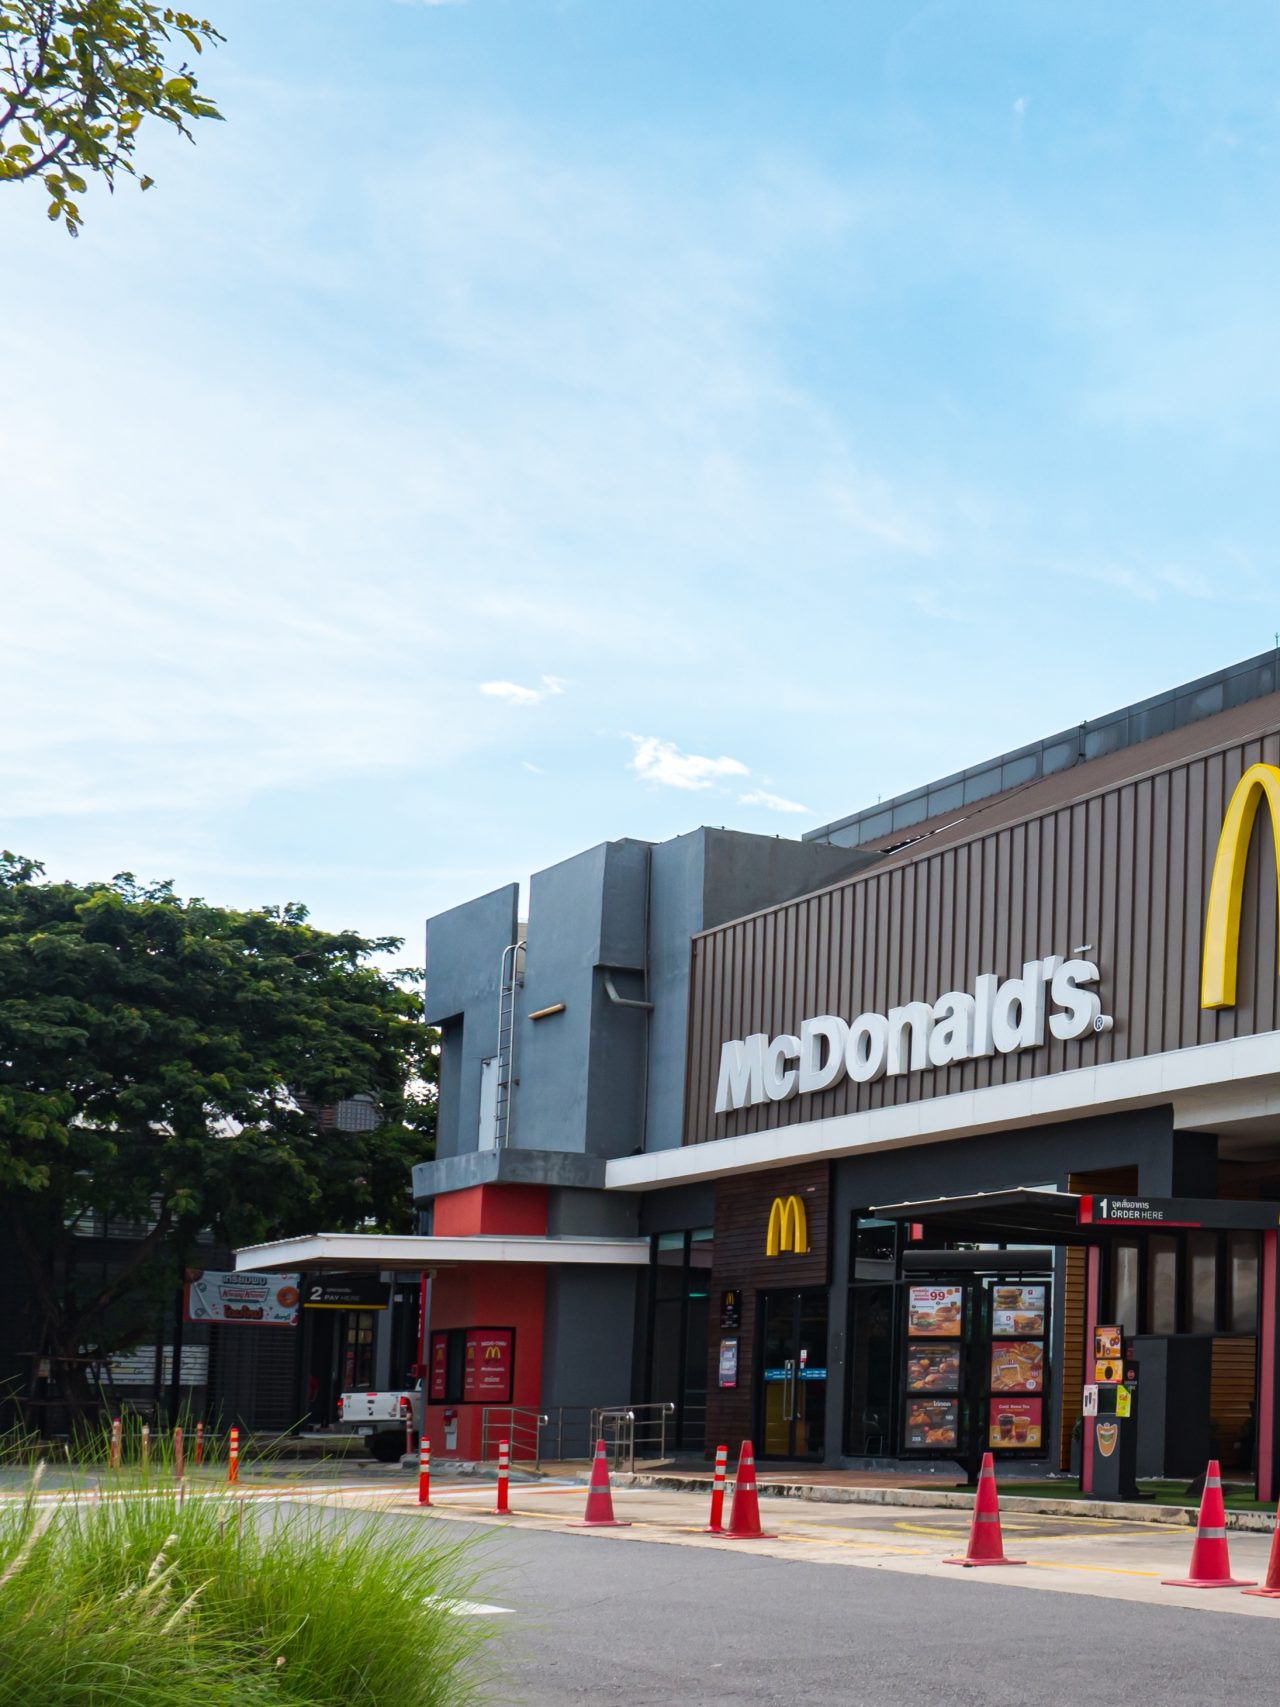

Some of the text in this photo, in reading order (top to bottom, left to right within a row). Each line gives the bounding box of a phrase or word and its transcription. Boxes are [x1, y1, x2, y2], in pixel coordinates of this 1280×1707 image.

[1100, 1198, 1108, 1219] 1
[1110, 1209, 1164, 1220] ORDER HERE
[309, 1286, 323, 1300] 2
